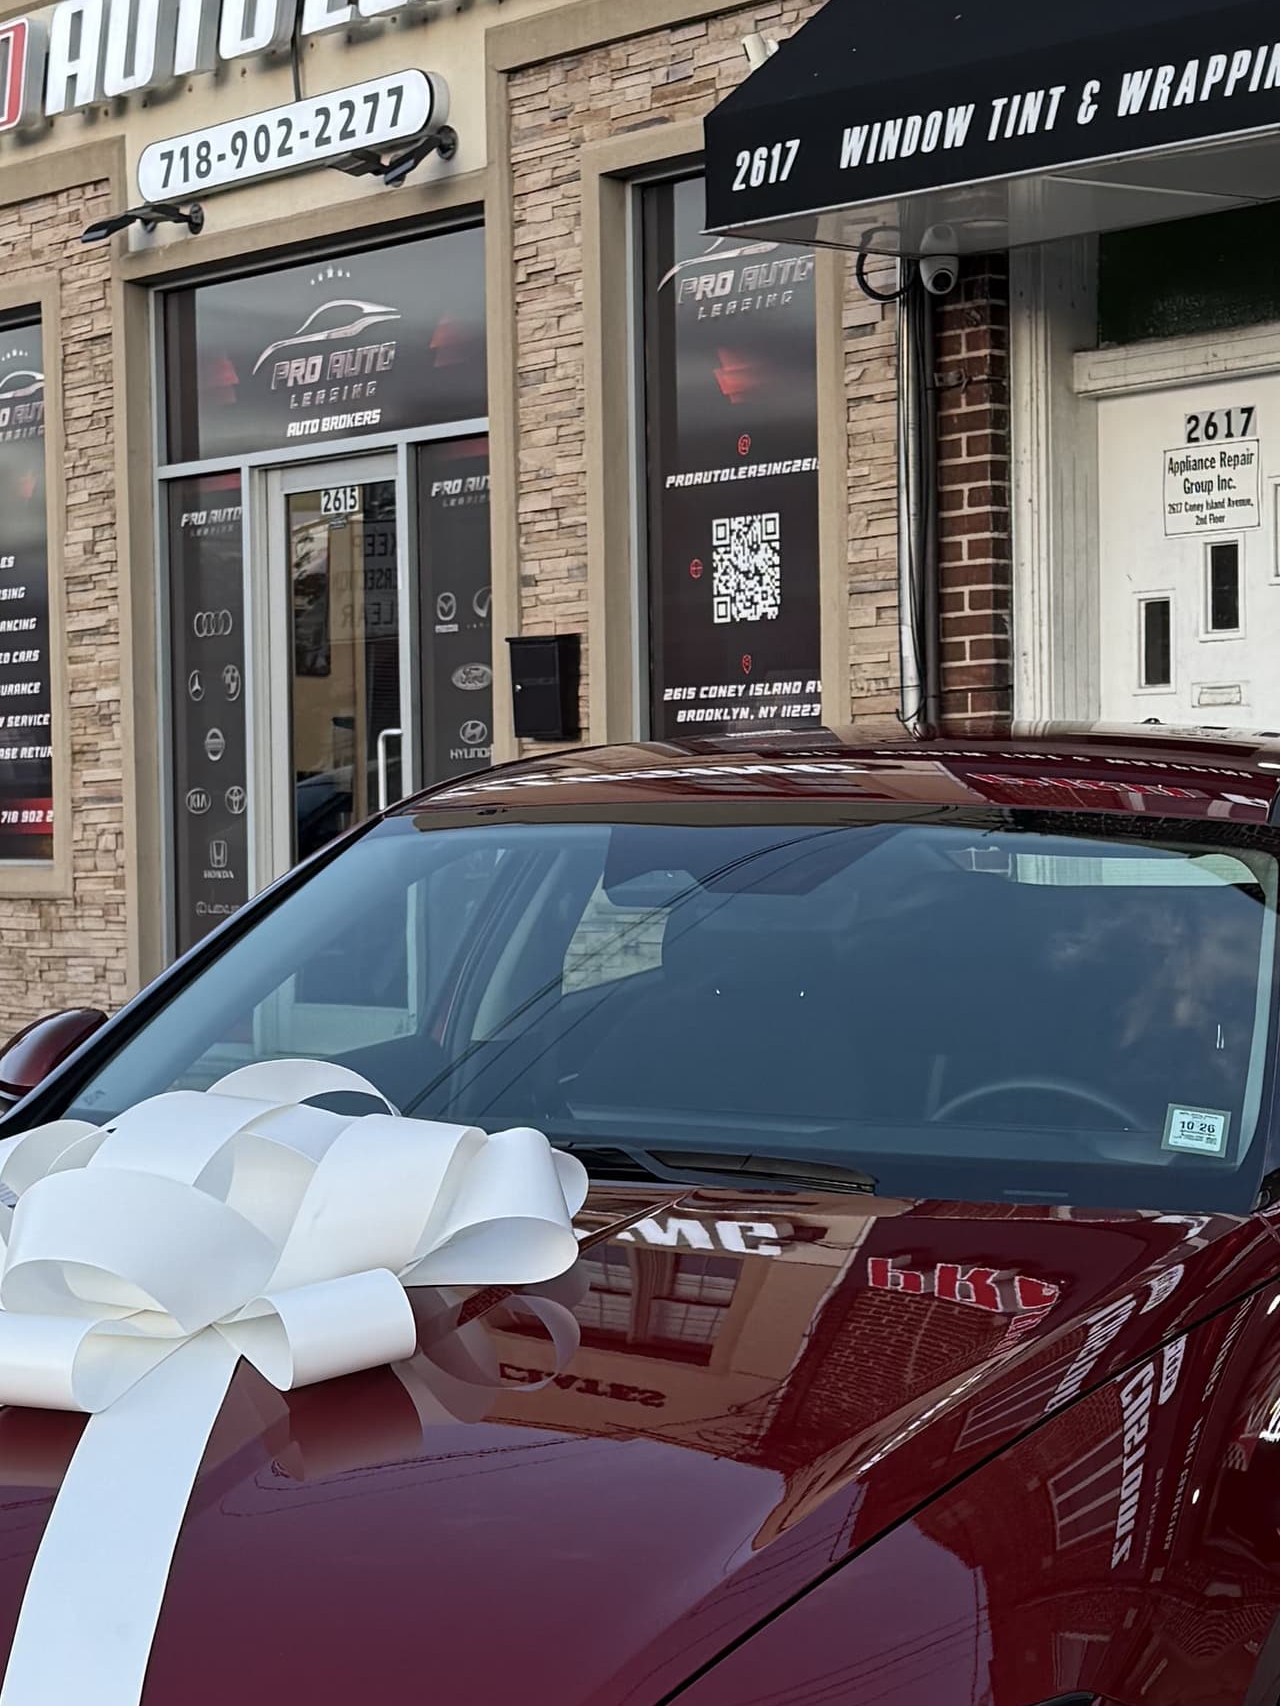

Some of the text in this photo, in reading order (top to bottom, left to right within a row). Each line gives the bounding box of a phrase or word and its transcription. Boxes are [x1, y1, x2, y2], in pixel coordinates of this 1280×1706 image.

[158, 84, 406, 189] 718-902-2277
[838, 103, 976, 170] WINDOW
[987, 85, 1066, 142] TINT
[1076, 79, 1102, 125] &
[731, 138, 801, 192] 2617
[678, 269, 735, 304] PRO
[697, 290, 794, 320] LEASING
[271, 341, 397, 390] PRO AUTO
[287, 408, 381, 437] AUTO BROKERS
[1186, 406, 1255, 444] 2617
[665, 457, 820, 488] PROAUTOLEASING261
[1168, 448, 1254, 477] Appliance Repair
[431, 479, 463, 497] PRO
[1183, 474, 1237, 495] Group Inc.
[323, 487, 359, 514] 2615
[181, 510, 207, 527] PRO
[12, 649, 40, 664] CARS
[664, 687, 695, 701] 2615
[699, 685, 747, 700] CONEY
[749, 682, 801, 697] ISLAND
[758, 705, 777, 719] NY
[1, 810, 17, 824] 718
[21, 809, 43, 823] 902
[204, 870, 234, 879] HONDA
[1180, 1120, 1216, 1134] 10 26
